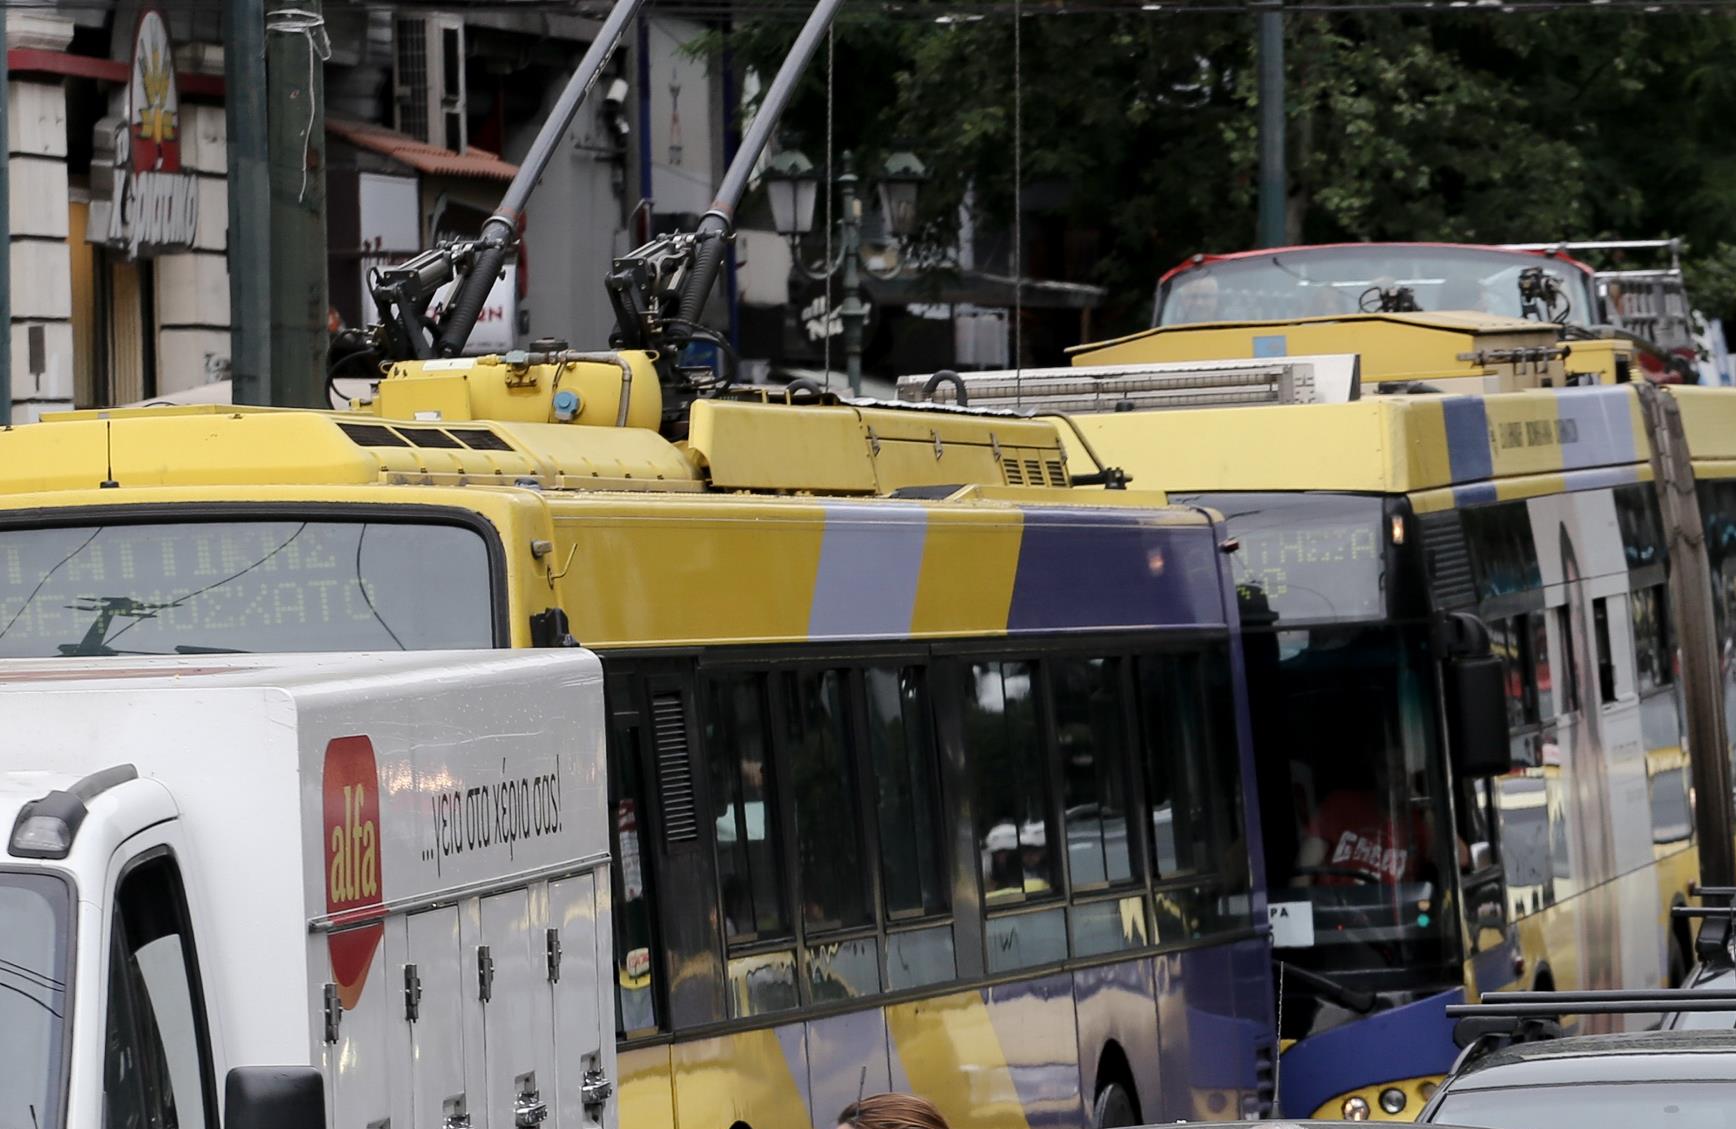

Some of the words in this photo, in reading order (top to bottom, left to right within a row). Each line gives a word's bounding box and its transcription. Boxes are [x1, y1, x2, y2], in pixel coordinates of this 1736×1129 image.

[331, 783, 377, 903] alfa
[466, 786, 491, 850] στα
[494, 757, 530, 862] χέρια
